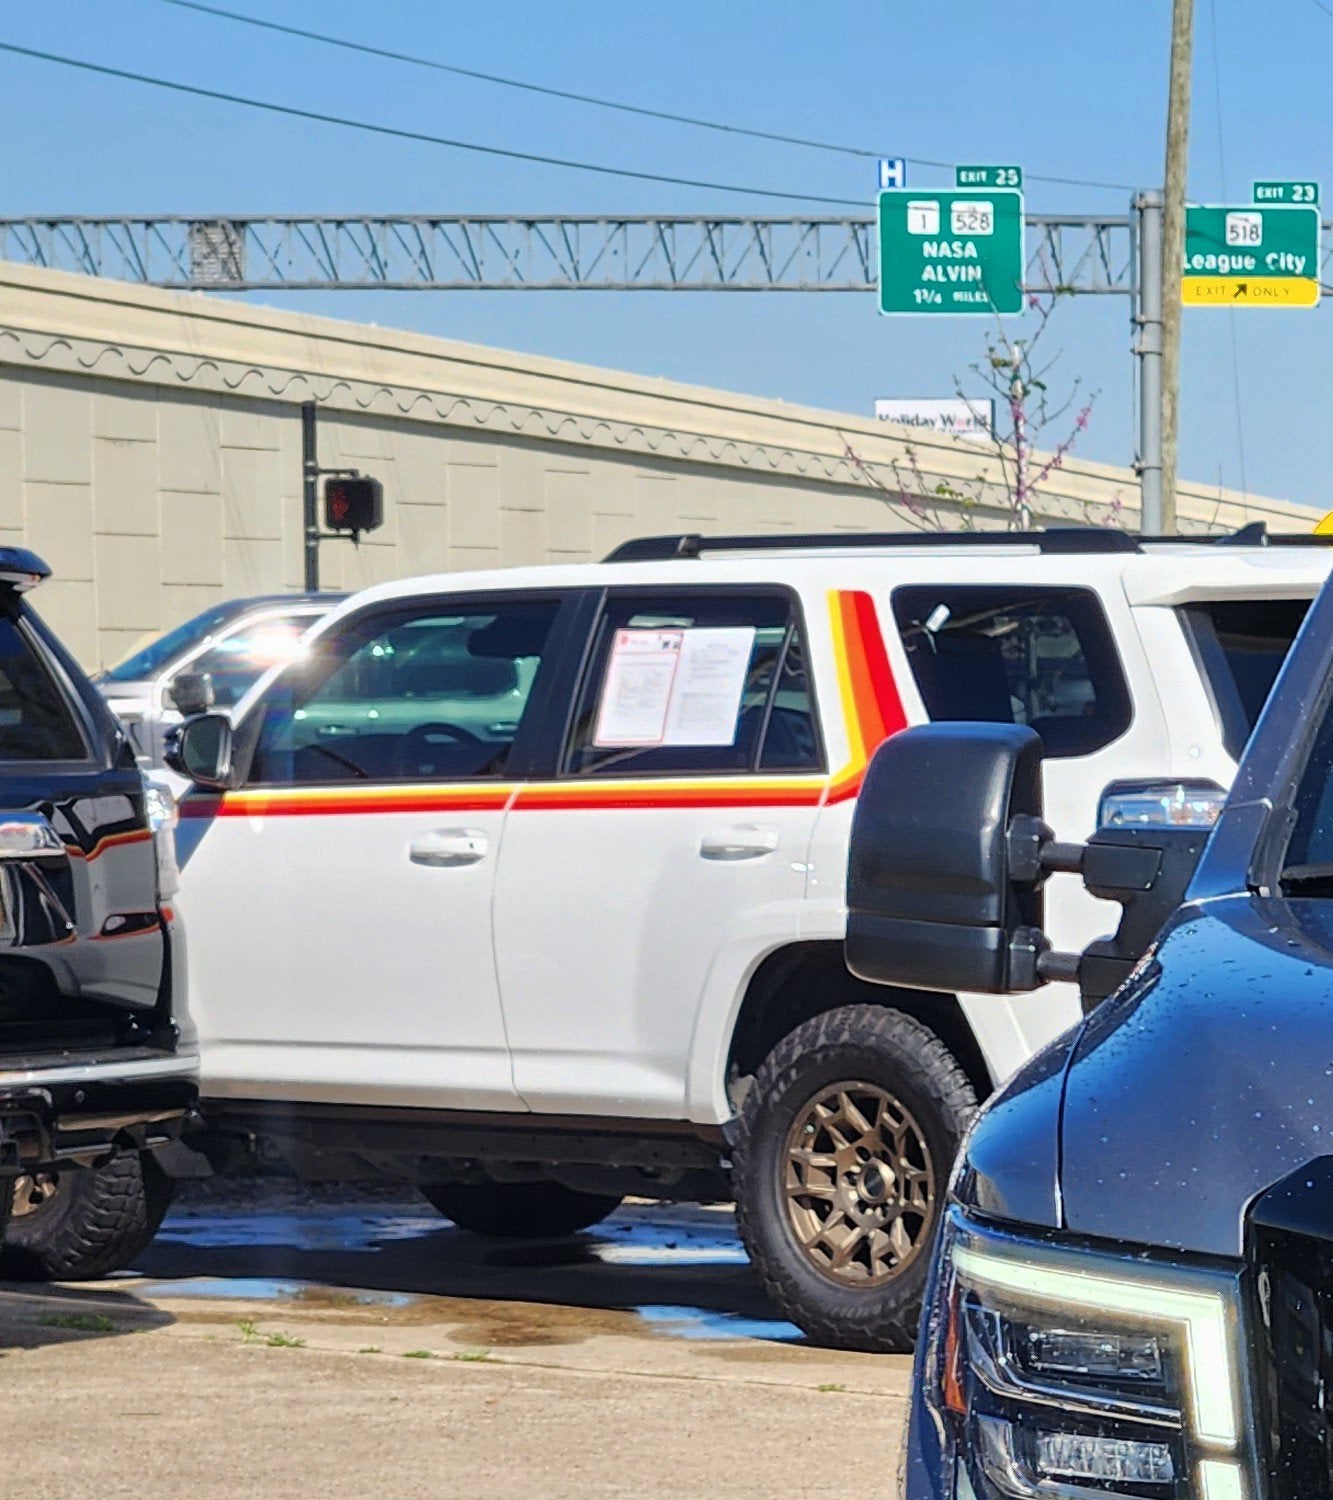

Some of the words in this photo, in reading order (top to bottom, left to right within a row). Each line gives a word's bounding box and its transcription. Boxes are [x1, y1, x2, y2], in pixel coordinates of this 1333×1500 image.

[959, 170, 987, 183] EXIT
[1256, 186, 1284, 199] EXIT
[1292, 184, 1316, 201] 23
[955, 212, 991, 231] 528
[1229, 223, 1260, 242] 518
[923, 241, 978, 258] NASA
[1265, 251, 1307, 275] City
[921, 265, 982, 282] ALVIN
[1196, 286, 1226, 297] EXIT
[1253, 286, 1292, 297] ONLY
